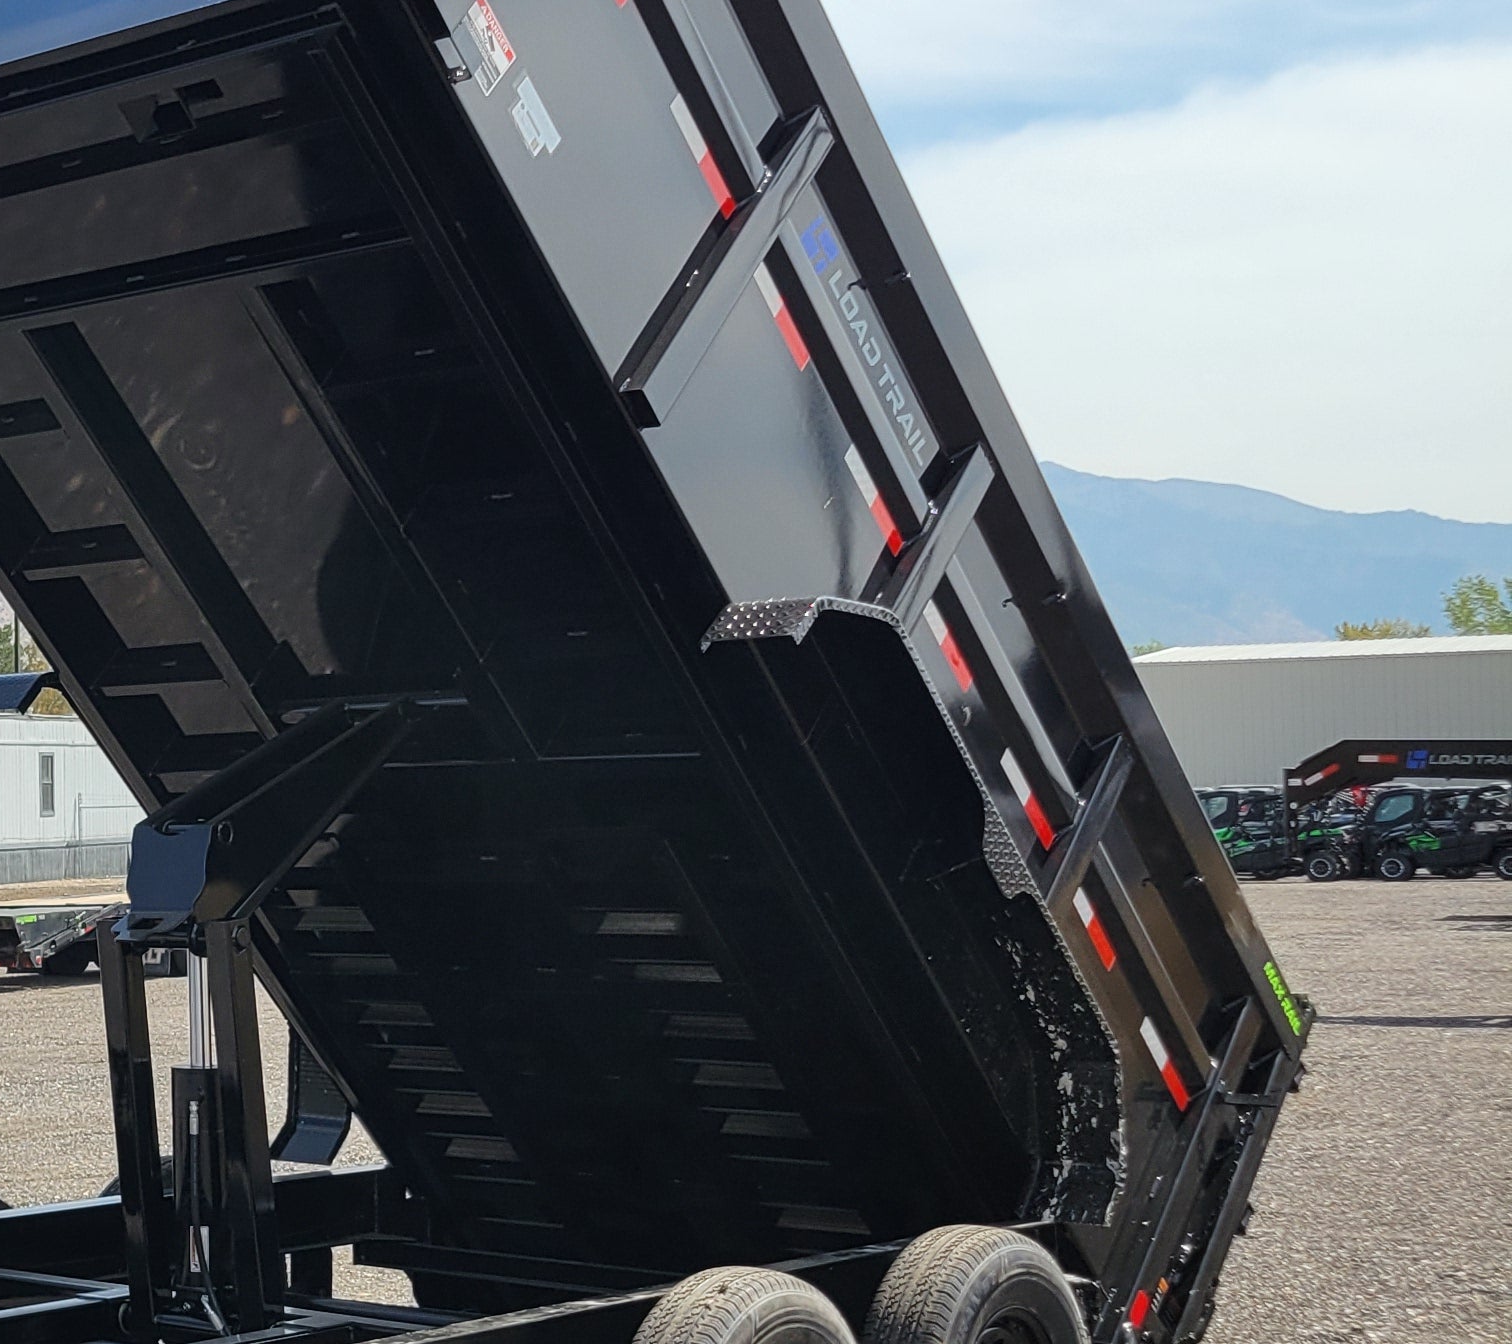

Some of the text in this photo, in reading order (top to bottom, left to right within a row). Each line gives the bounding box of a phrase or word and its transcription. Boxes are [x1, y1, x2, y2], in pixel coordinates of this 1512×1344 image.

[486, 11, 509, 54] DANGER
[828, 268, 926, 467] LOAD TRAIL
[1429, 754, 1512, 765] LOAD TRAI
[1263, 961, 1301, 1036] MAX RAIL
